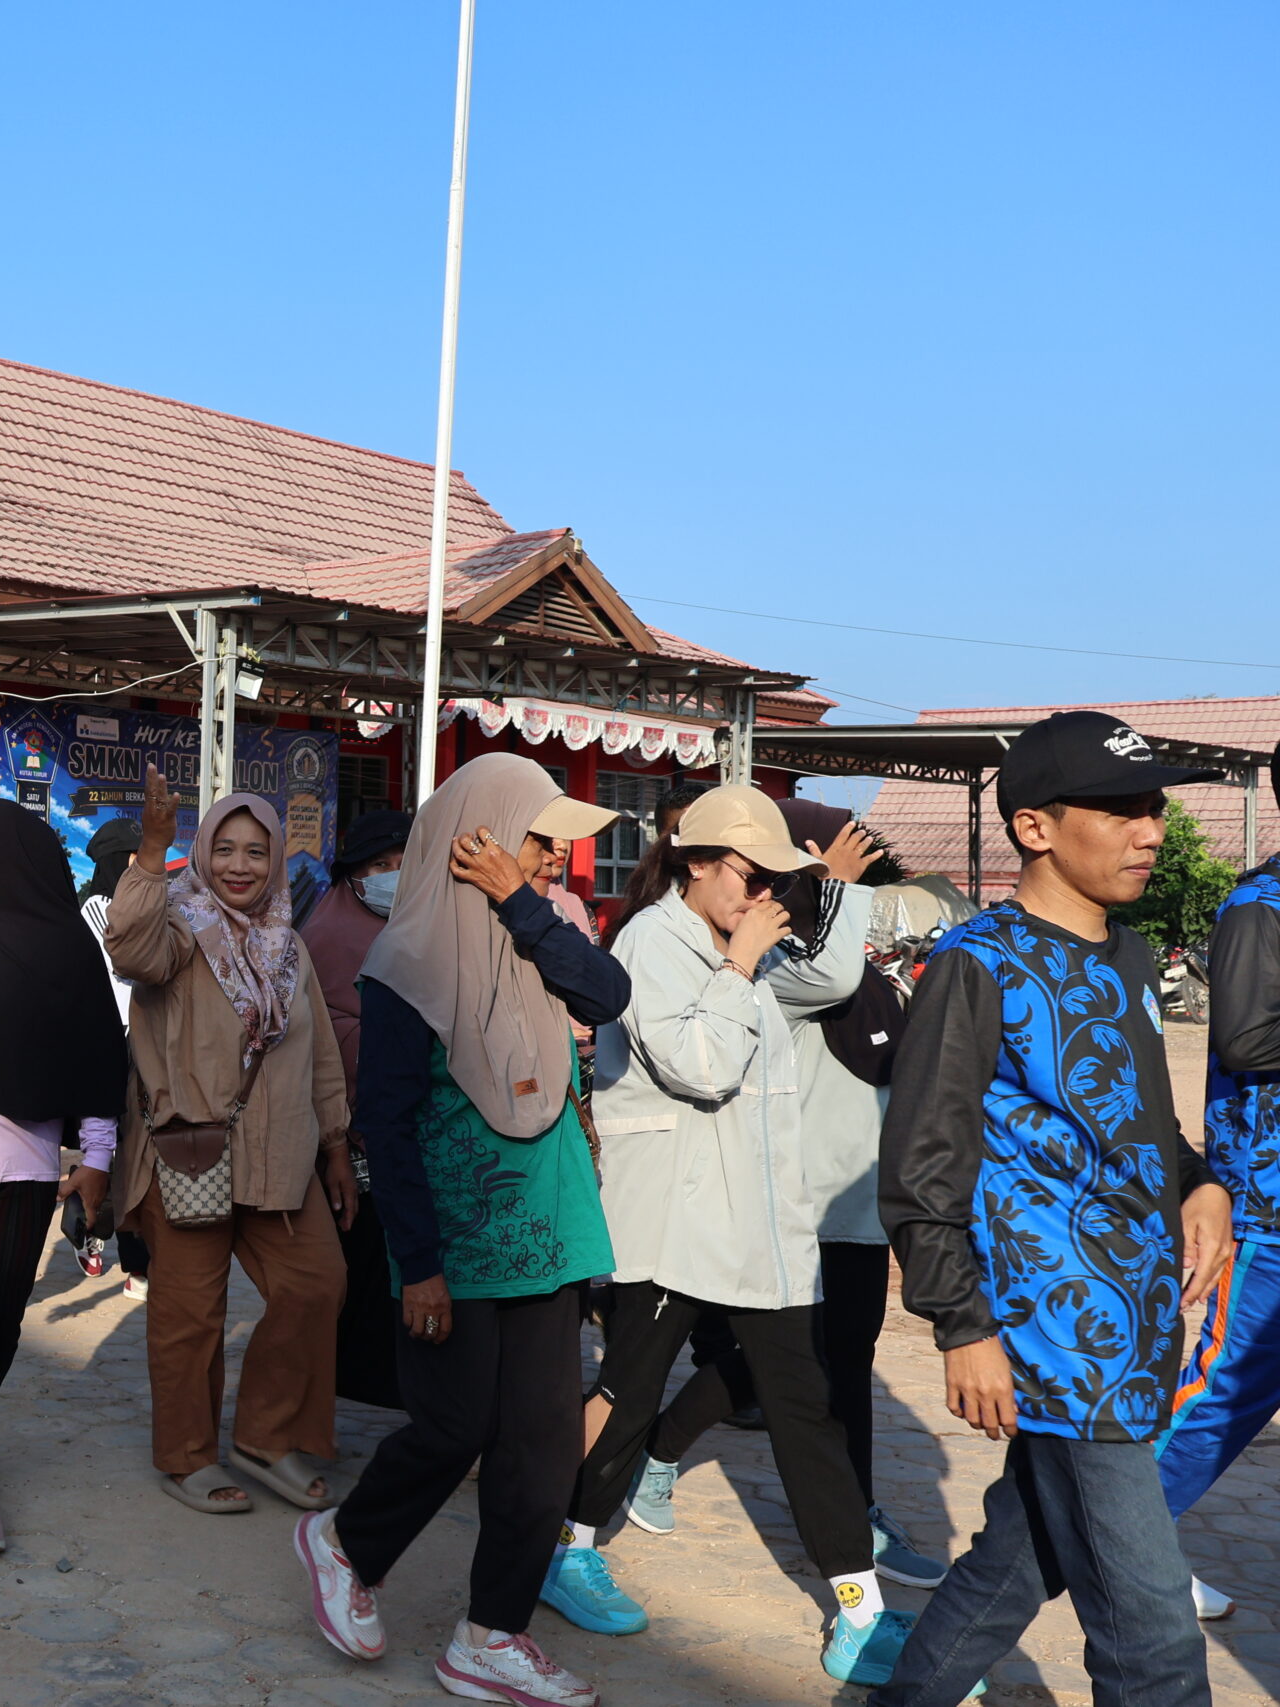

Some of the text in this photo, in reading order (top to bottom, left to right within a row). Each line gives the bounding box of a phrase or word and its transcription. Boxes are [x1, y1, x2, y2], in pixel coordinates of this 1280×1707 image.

[134, 725, 172, 745] HUT
[68, 742, 141, 782] SMKN
[26, 792, 41, 802] SATU
[88, 791, 99, 801] 22
[101, 791, 123, 801] TAHUN
[472, 1653, 535, 1693] Ortuseight
